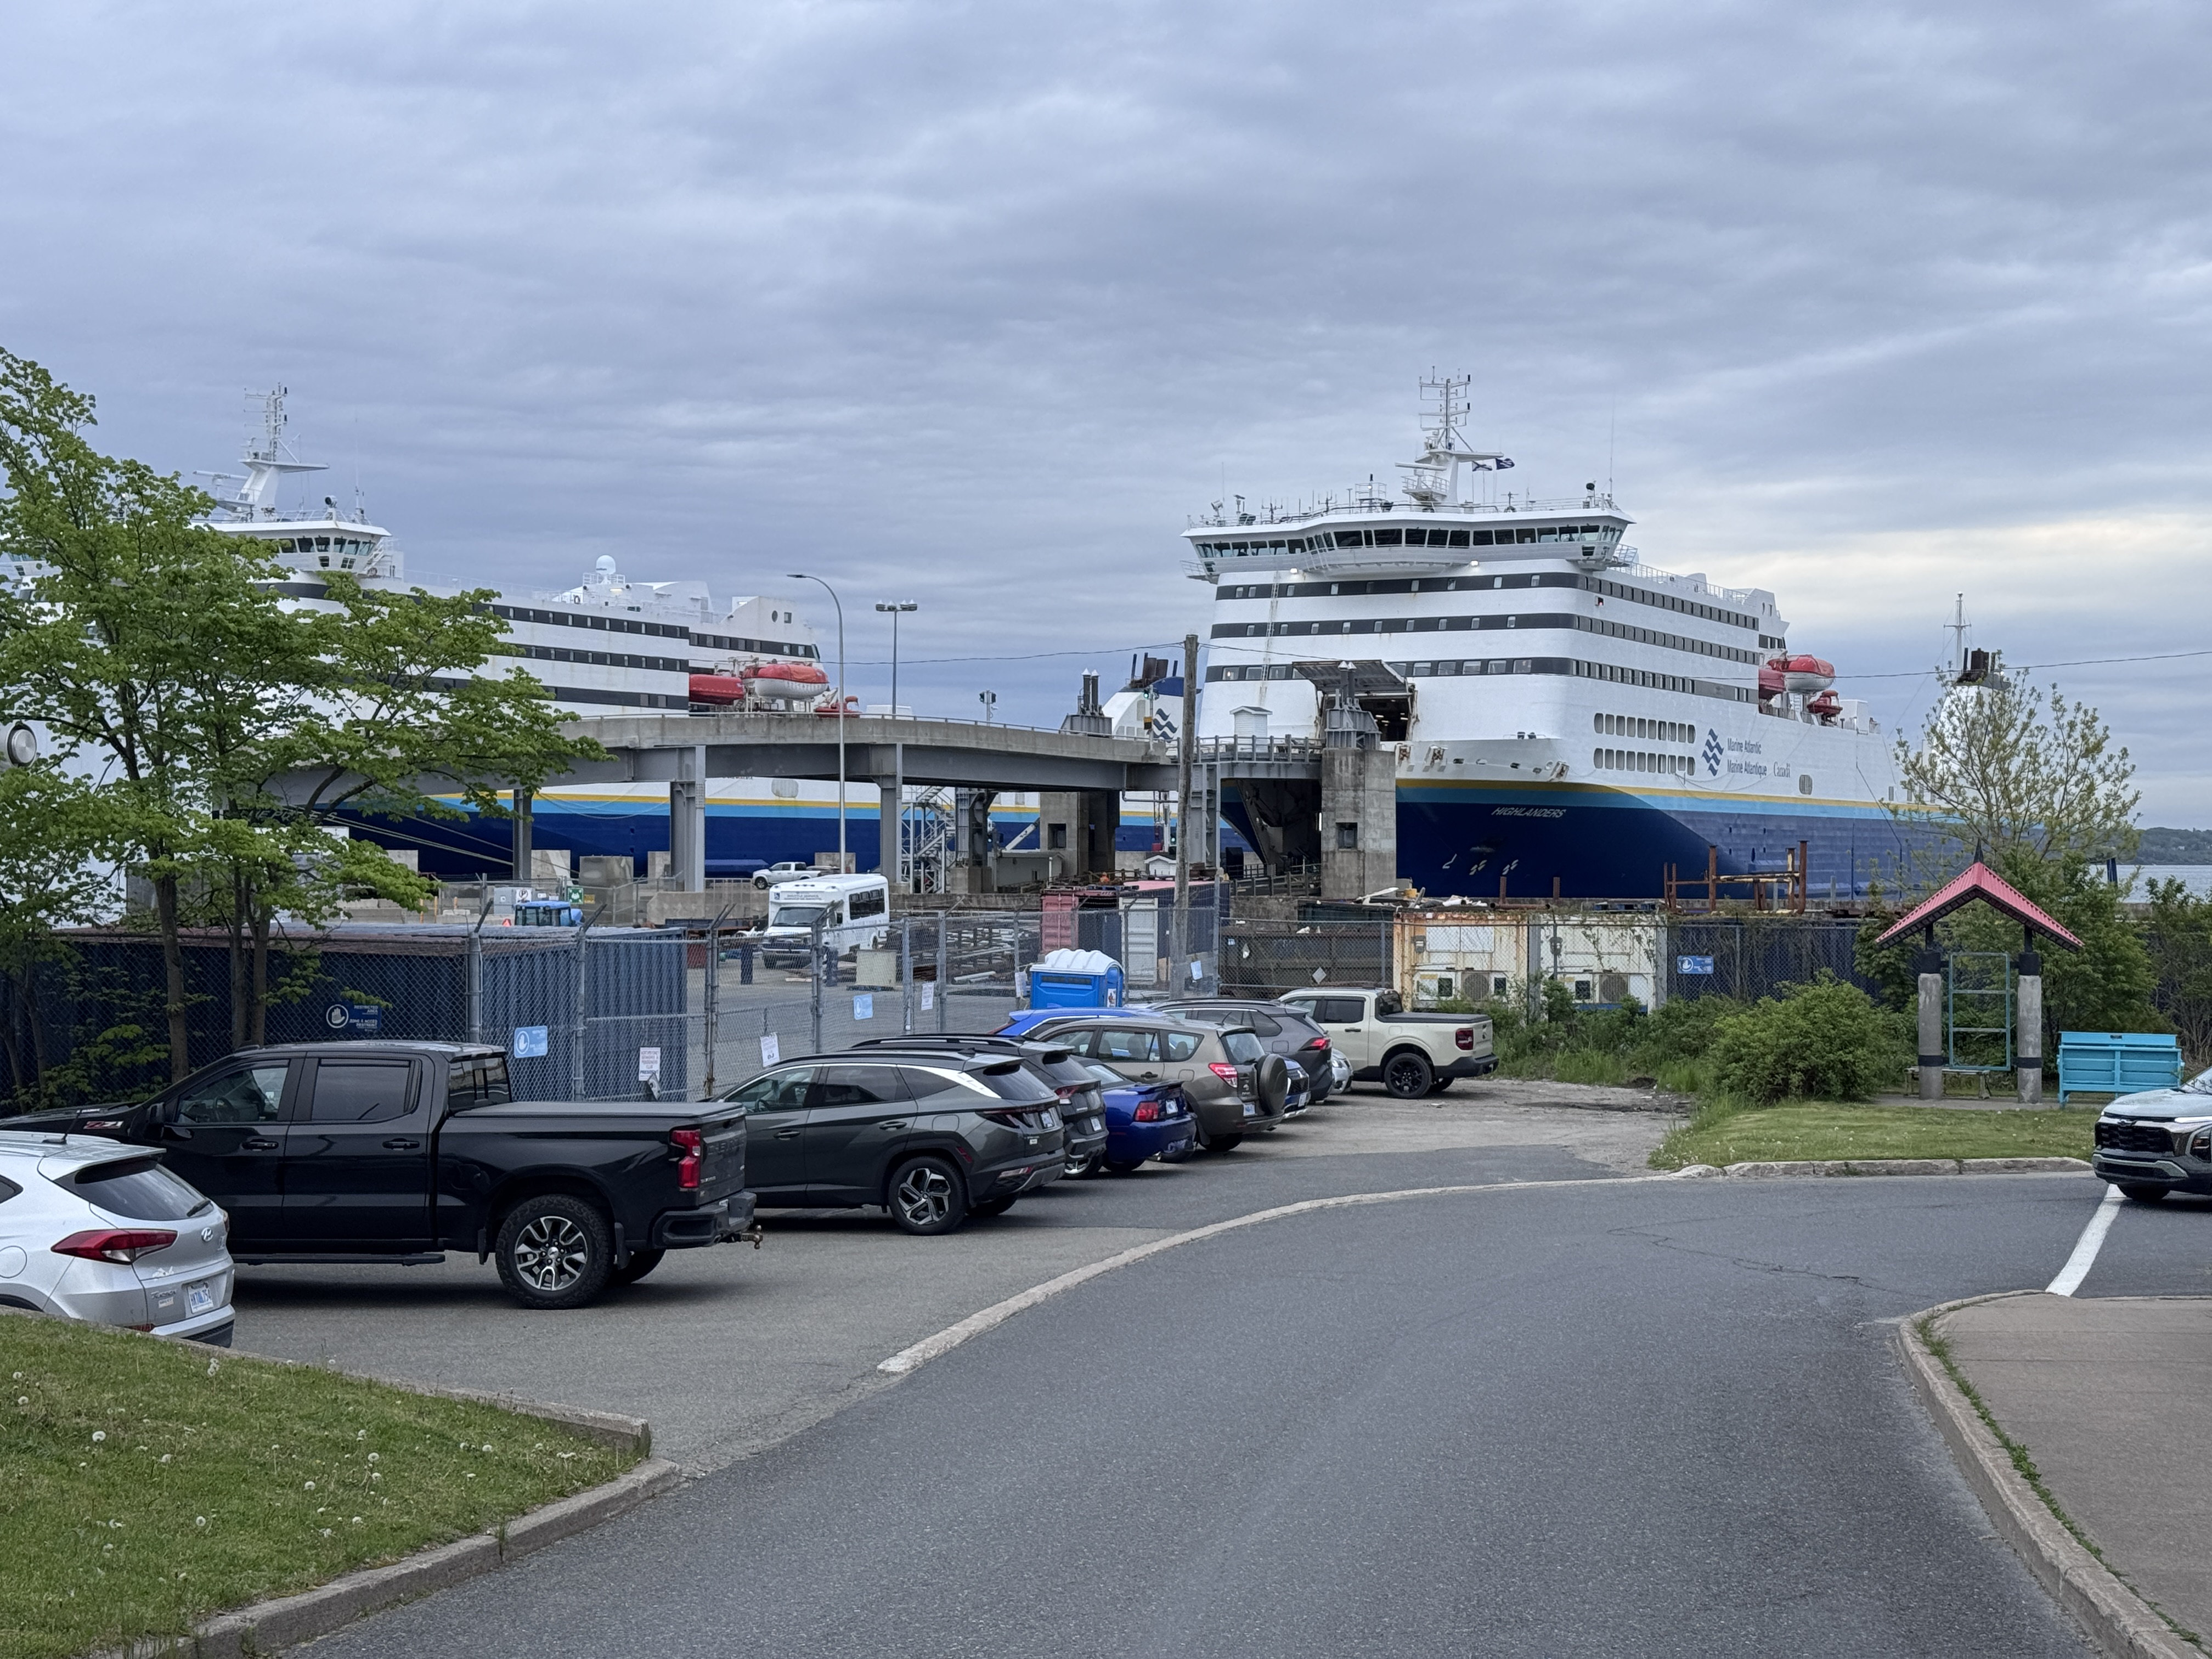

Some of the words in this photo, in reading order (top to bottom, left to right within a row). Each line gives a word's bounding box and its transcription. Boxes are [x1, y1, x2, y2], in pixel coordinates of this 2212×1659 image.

[1727, 737, 1743, 753] Marine
[1744, 740, 1762, 755] Atlantic
[1727, 759, 1743, 774] Marine
[1744, 760, 1767, 779] Atlantique
[1491, 807, 1567, 818] HIGHLANDERS
[83, 1121, 124, 1130] Z71
